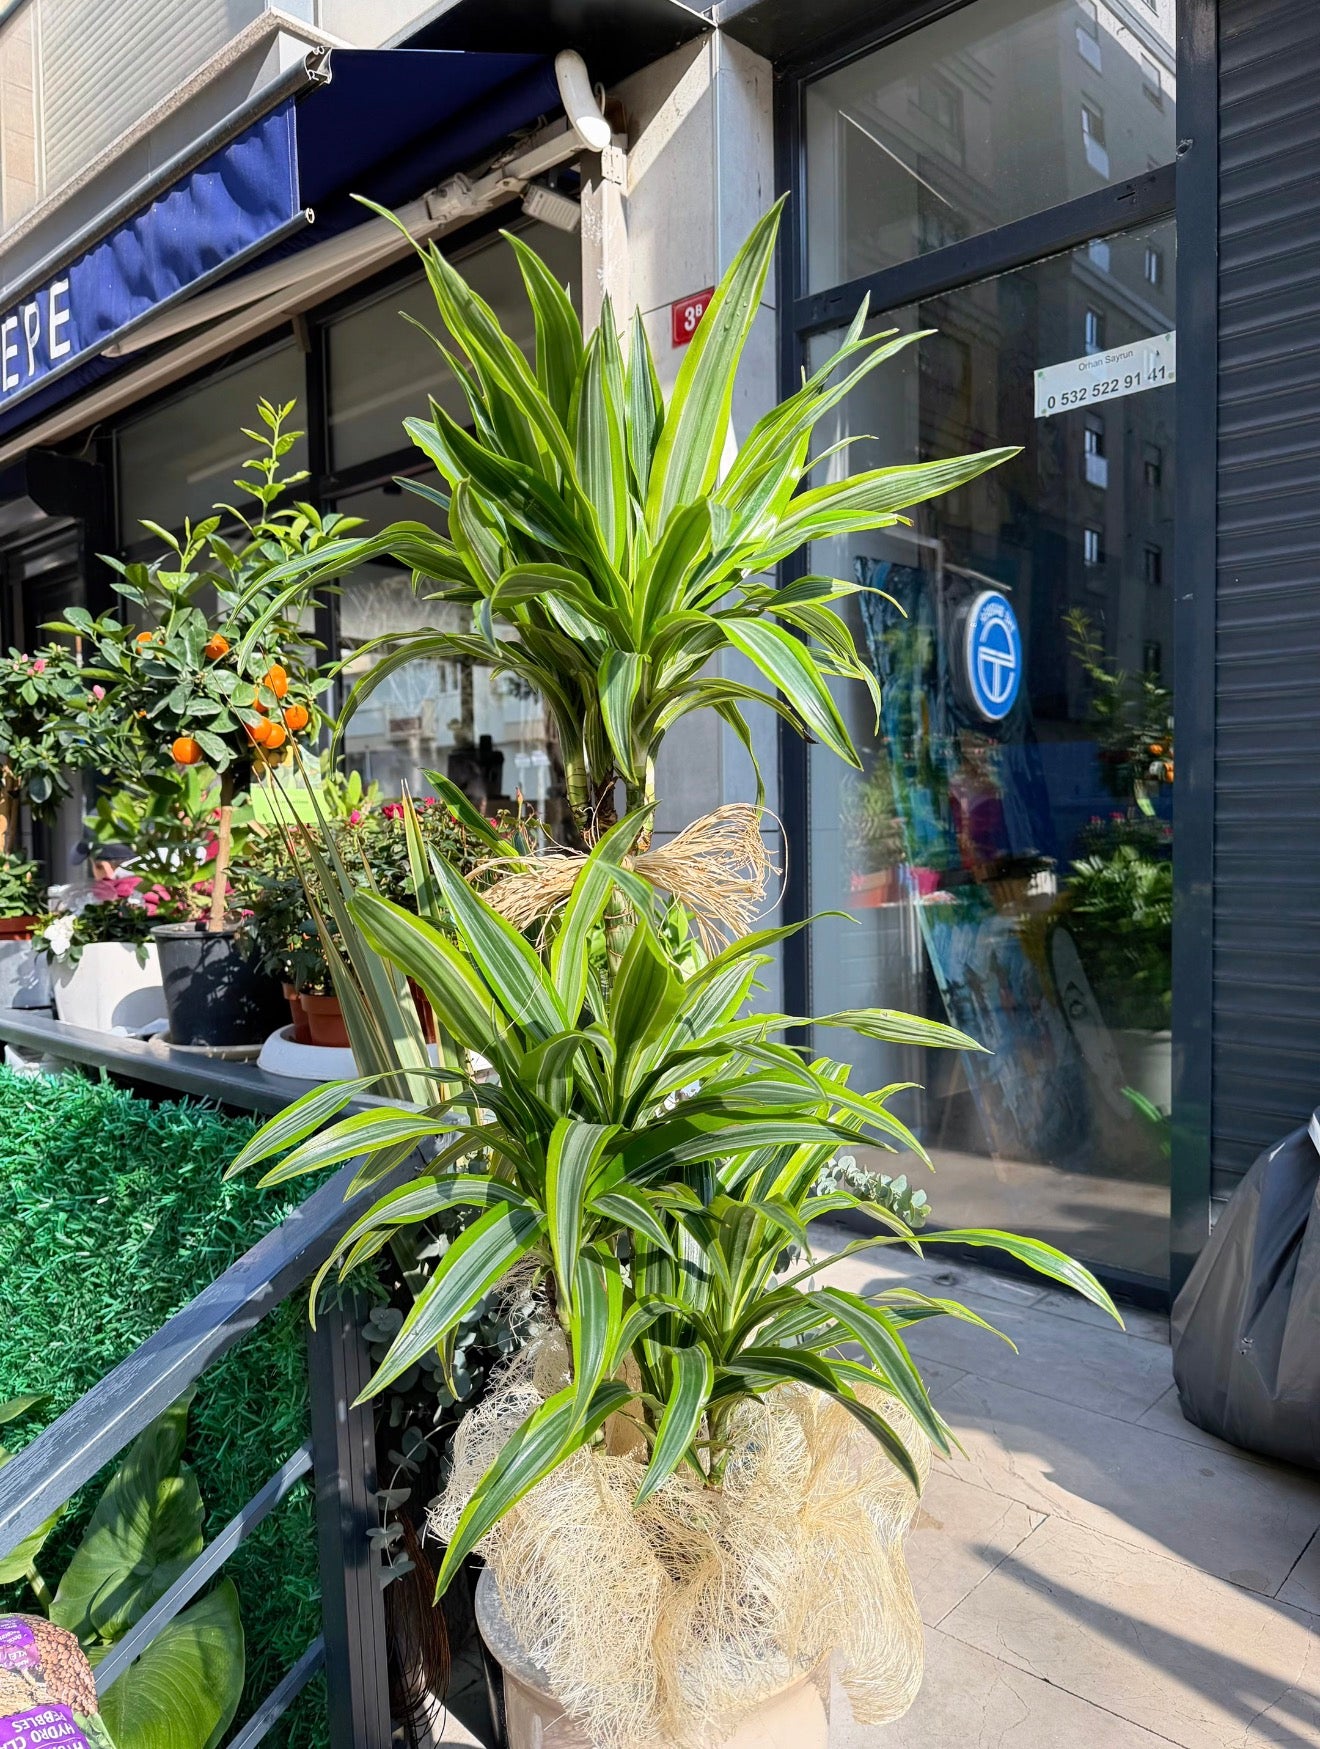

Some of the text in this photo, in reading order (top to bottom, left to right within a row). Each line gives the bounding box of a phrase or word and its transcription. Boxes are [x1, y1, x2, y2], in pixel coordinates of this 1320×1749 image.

[1078, 359, 1103, 371] Orhan
[1047, 365, 1165, 409] 0 532 522 91 41
[11, 1710, 67, 1733] PEBBLES
[30, 1722, 75, 1743] HYDRO
